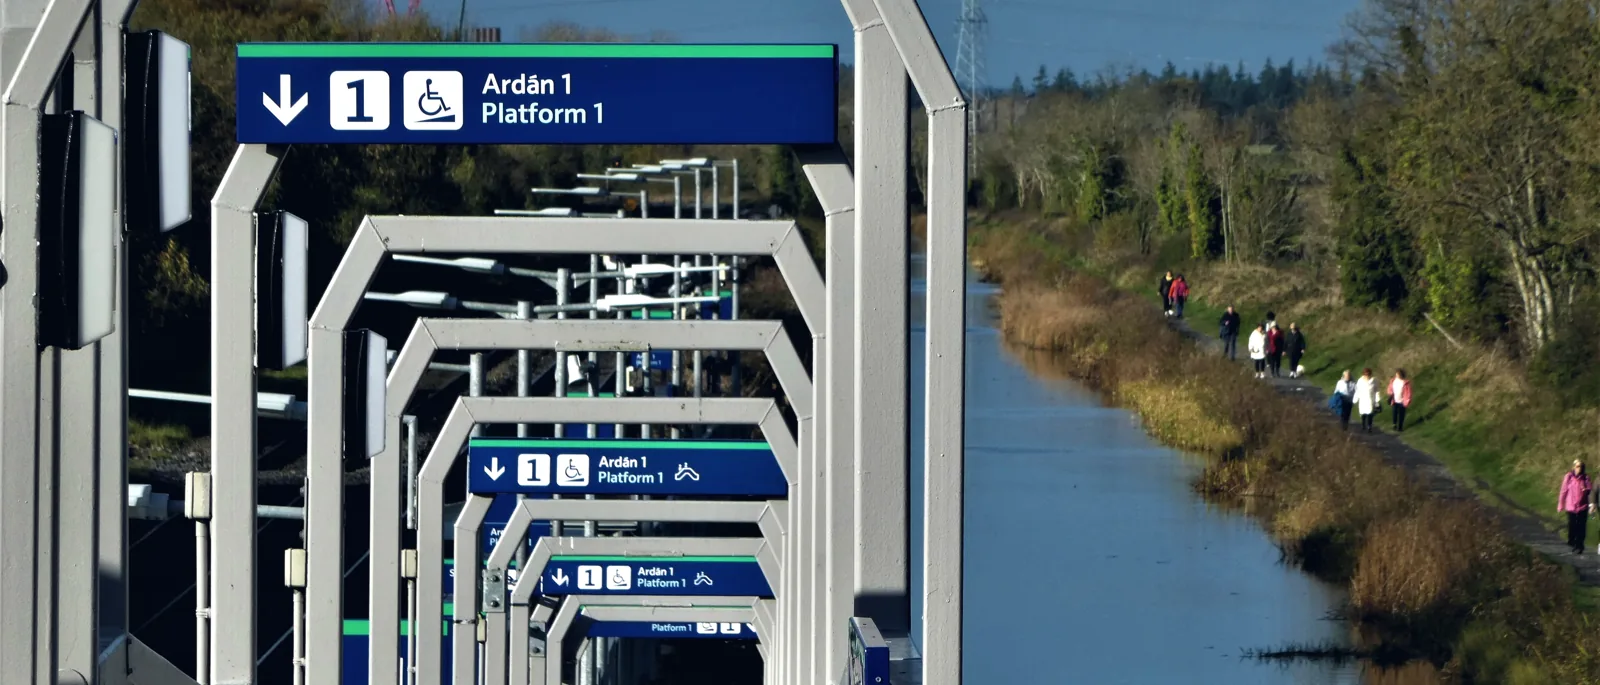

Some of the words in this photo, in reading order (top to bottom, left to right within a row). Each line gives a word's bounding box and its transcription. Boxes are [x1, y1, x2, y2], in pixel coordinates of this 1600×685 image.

[482, 73, 554, 95] Ardán
[561, 73, 571, 94] 1
[347, 78, 373, 122] 1
[482, 102, 586, 124] Platform
[593, 102, 603, 123] 1
[598, 456, 638, 468] Ardán
[641, 456, 647, 468] 1
[527, 459, 541, 481] 1
[598, 471, 654, 483] Platform
[657, 472, 663, 483] 1
[585, 569, 595, 586] 1
[637, 567, 667, 576] Ardán
[669, 567, 674, 576] 1
[637, 578, 679, 588] Platform
[681, 579, 686, 587] 1
[652, 623, 686, 632] Platform
